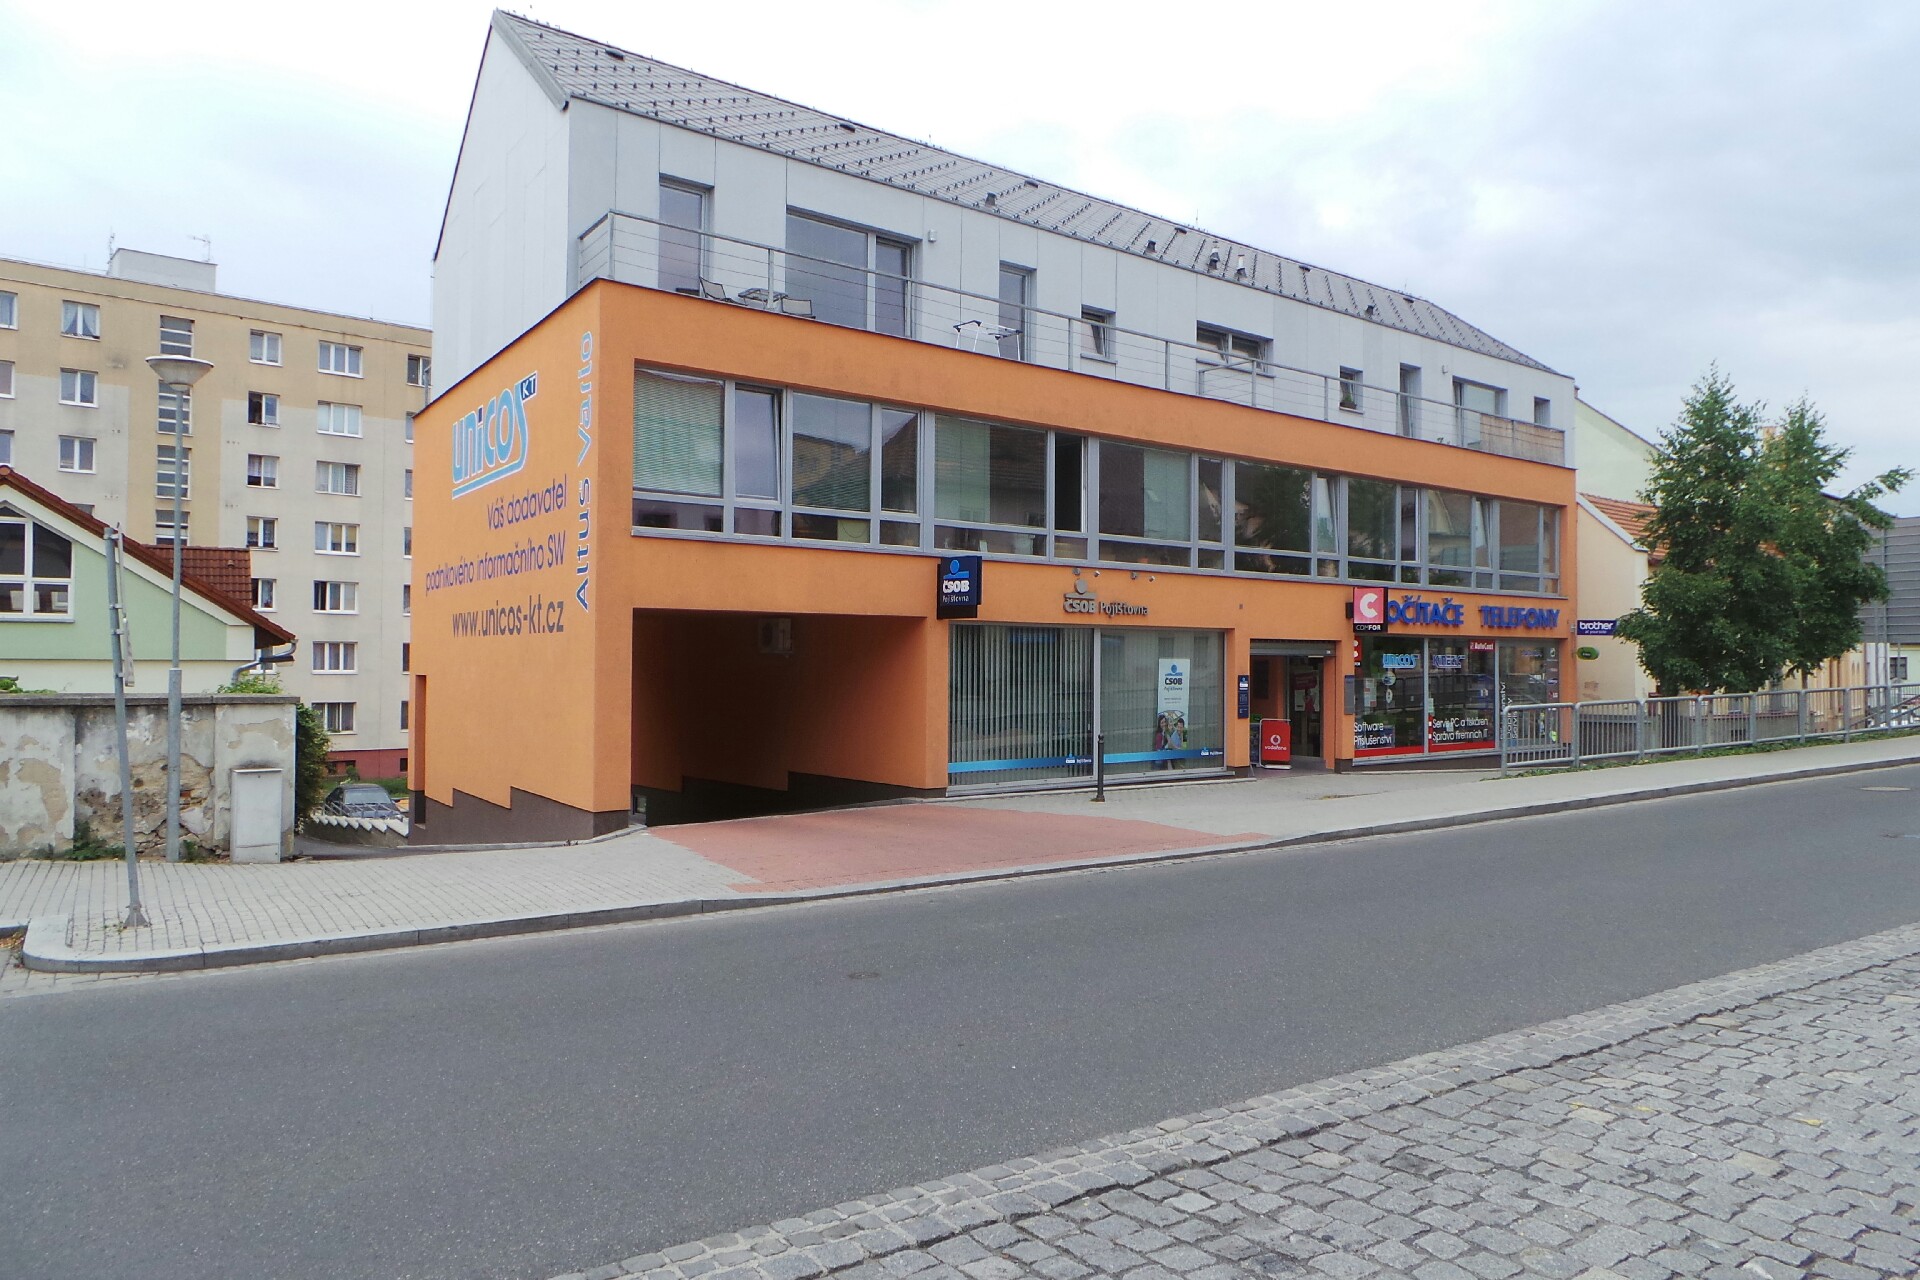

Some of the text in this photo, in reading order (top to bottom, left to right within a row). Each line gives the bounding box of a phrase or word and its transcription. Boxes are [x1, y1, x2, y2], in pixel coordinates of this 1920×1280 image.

[522, 374, 537, 399] KT
[487, 473, 567, 530] Váš dodavatel
[576, 478, 590, 612] Altus
[425, 530, 566, 597] podnikového informačního SW
[943, 580, 970, 593] ČSOB
[1064, 599, 1097, 613] ČSOB
[1388, 595, 1560, 629] OČÍTAČE TELEFONY
[452, 594, 564, 638] www.unicos-kt.cz
[1579, 621, 1613, 630] brother
[1164, 677, 1183, 686] ČSOB
[1354, 722, 1384, 733] Software
[1450, 717, 1460, 727] PC
[1432, 731, 1455, 743] Správa
